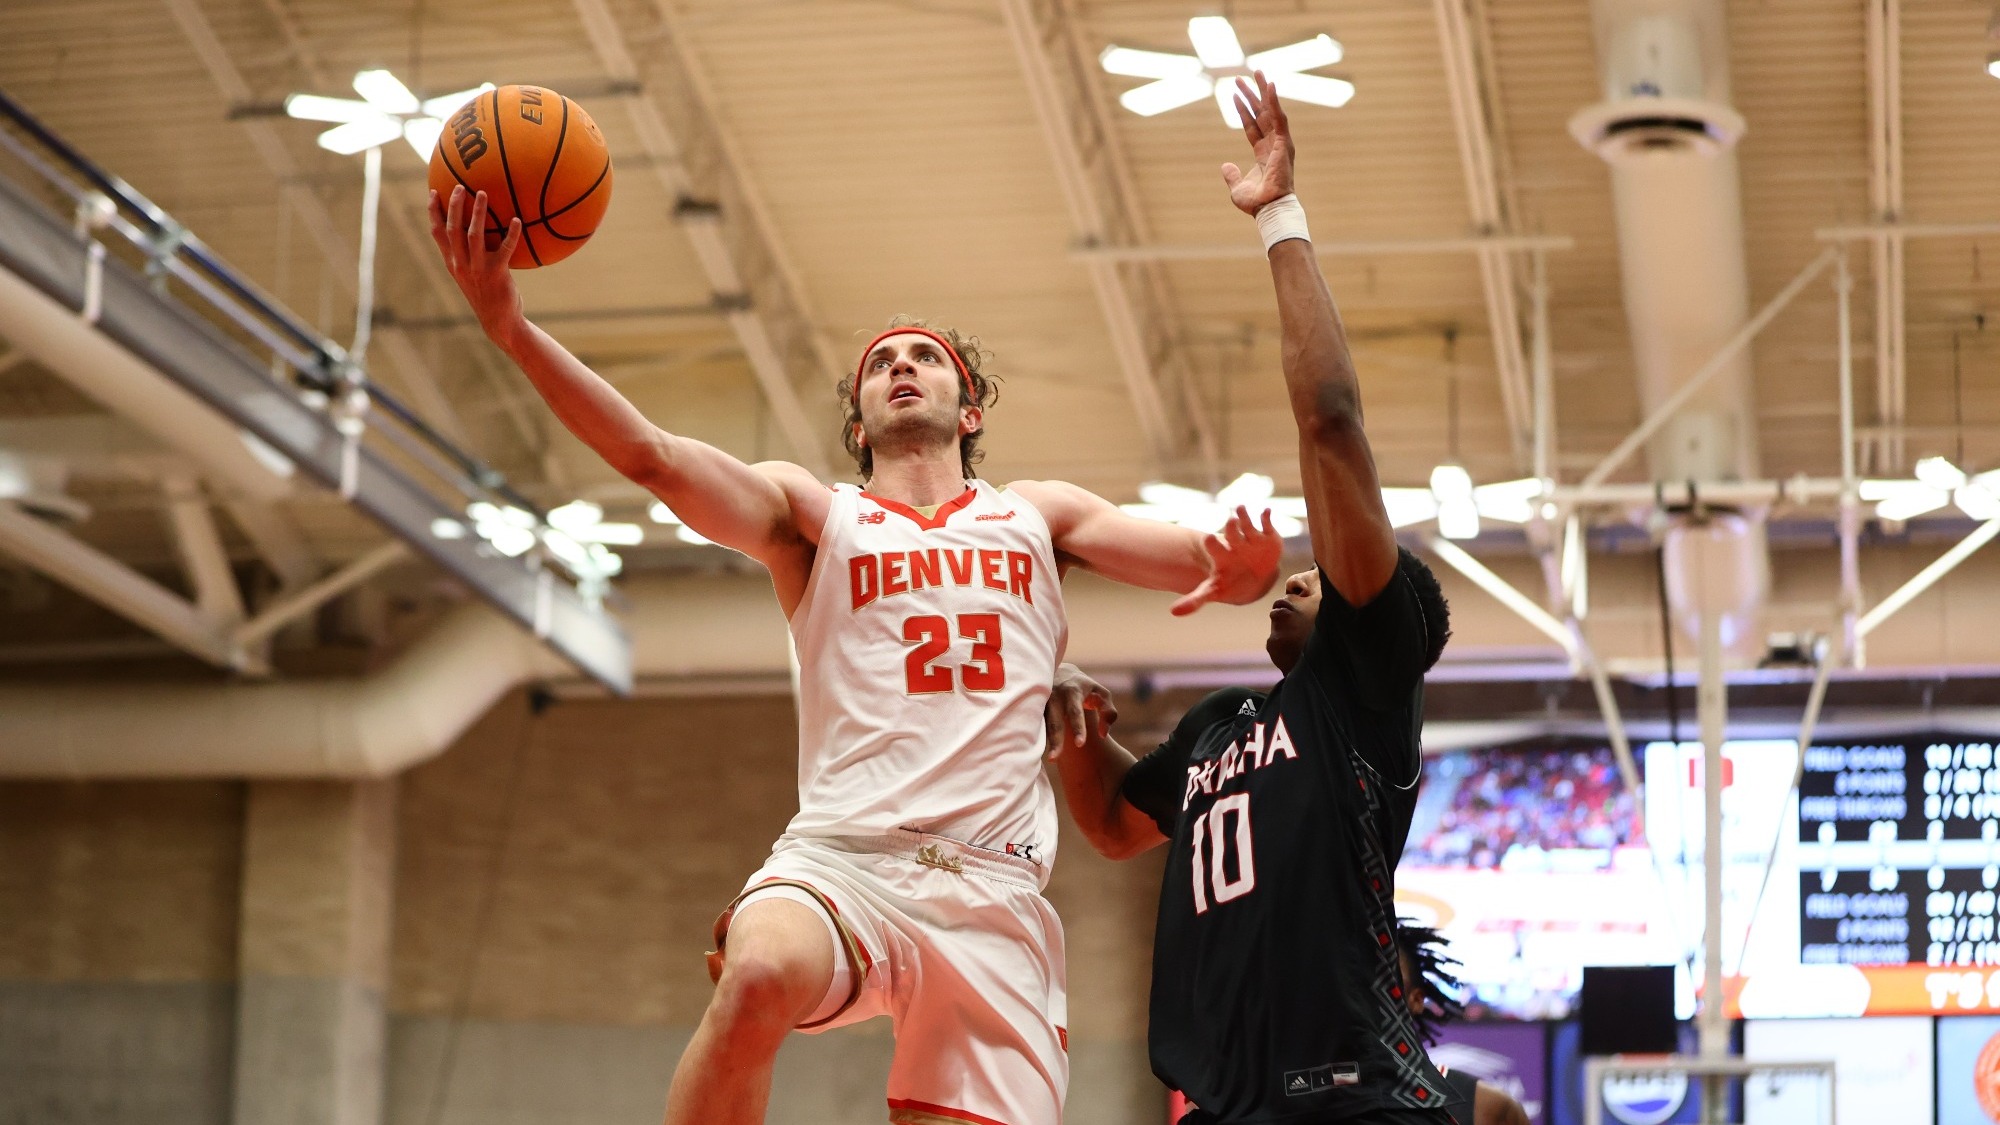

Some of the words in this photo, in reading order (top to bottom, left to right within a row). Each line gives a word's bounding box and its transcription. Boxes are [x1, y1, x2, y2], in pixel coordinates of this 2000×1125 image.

[848, 548, 1035, 613] DENVER
[902, 613, 1006, 695] 23
[1191, 792, 1256, 916] 10
